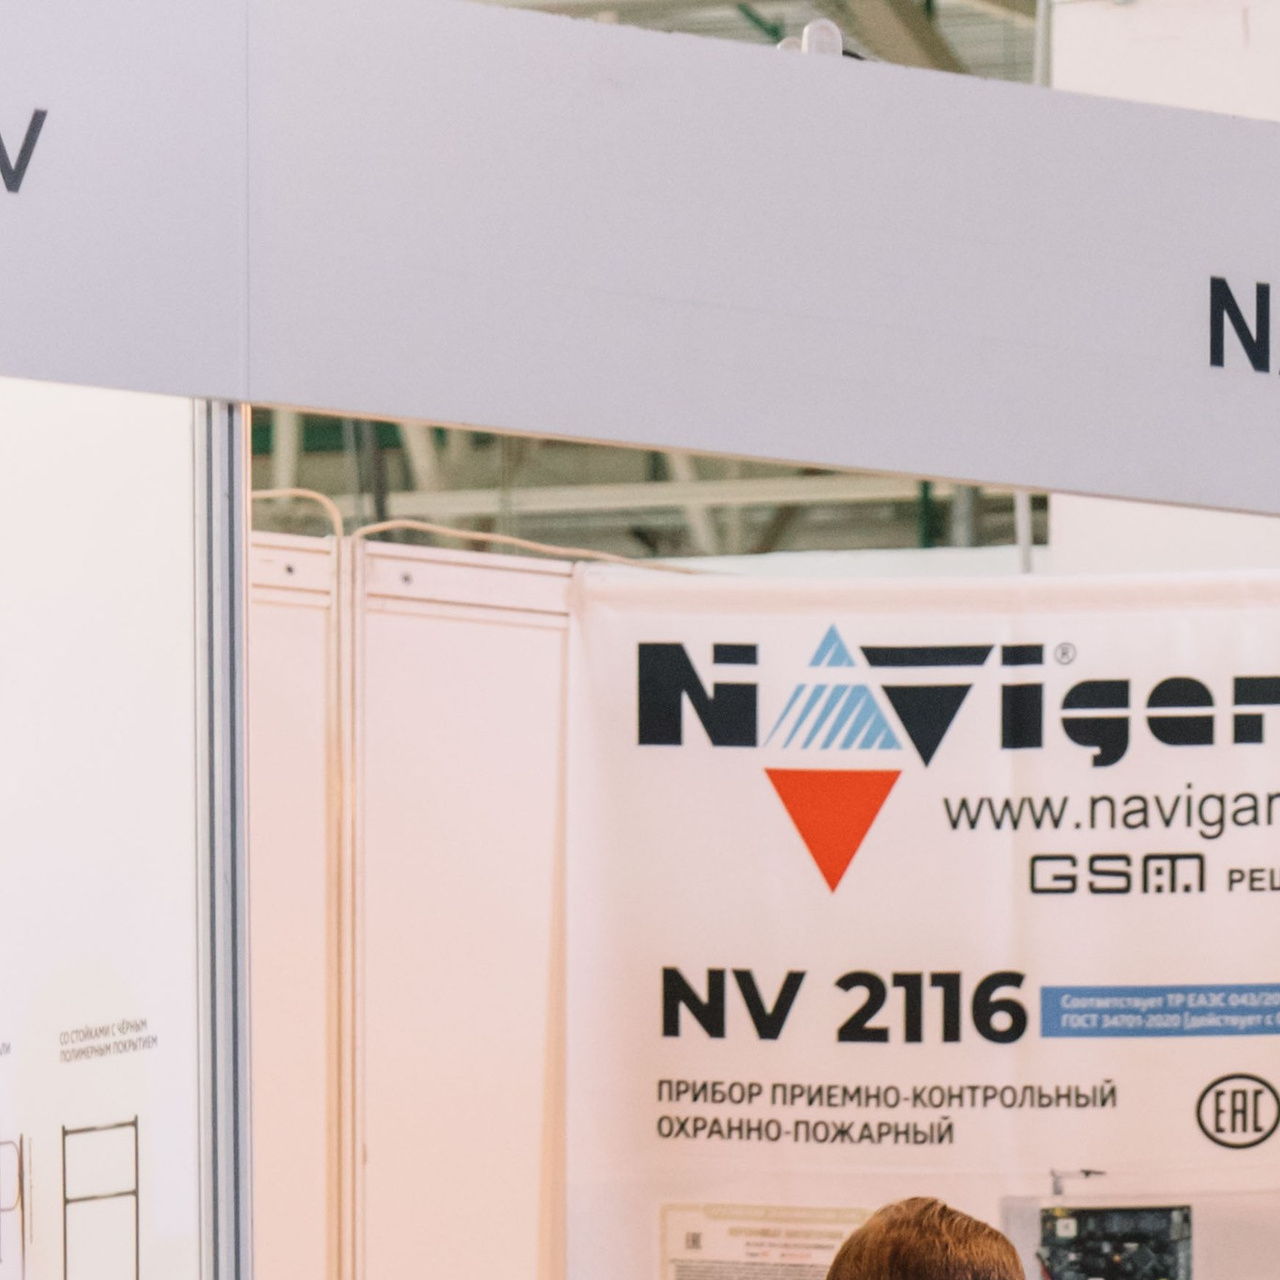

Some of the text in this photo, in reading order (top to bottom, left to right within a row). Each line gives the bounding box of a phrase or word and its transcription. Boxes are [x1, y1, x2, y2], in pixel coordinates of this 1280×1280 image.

[1029, 852, 1205, 895] GSM
[662, 966, 1028, 1045] NV 2116
[1060, 1013, 1099, 1028] ГОСТ
[656, 1080, 1118, 1111] ПРИБОР ПРИЕМНО-КОНТРОЛЬНЫЙ
[656, 1116, 954, 1146] ОХРАННО-ПОЖАРНЫЙ
